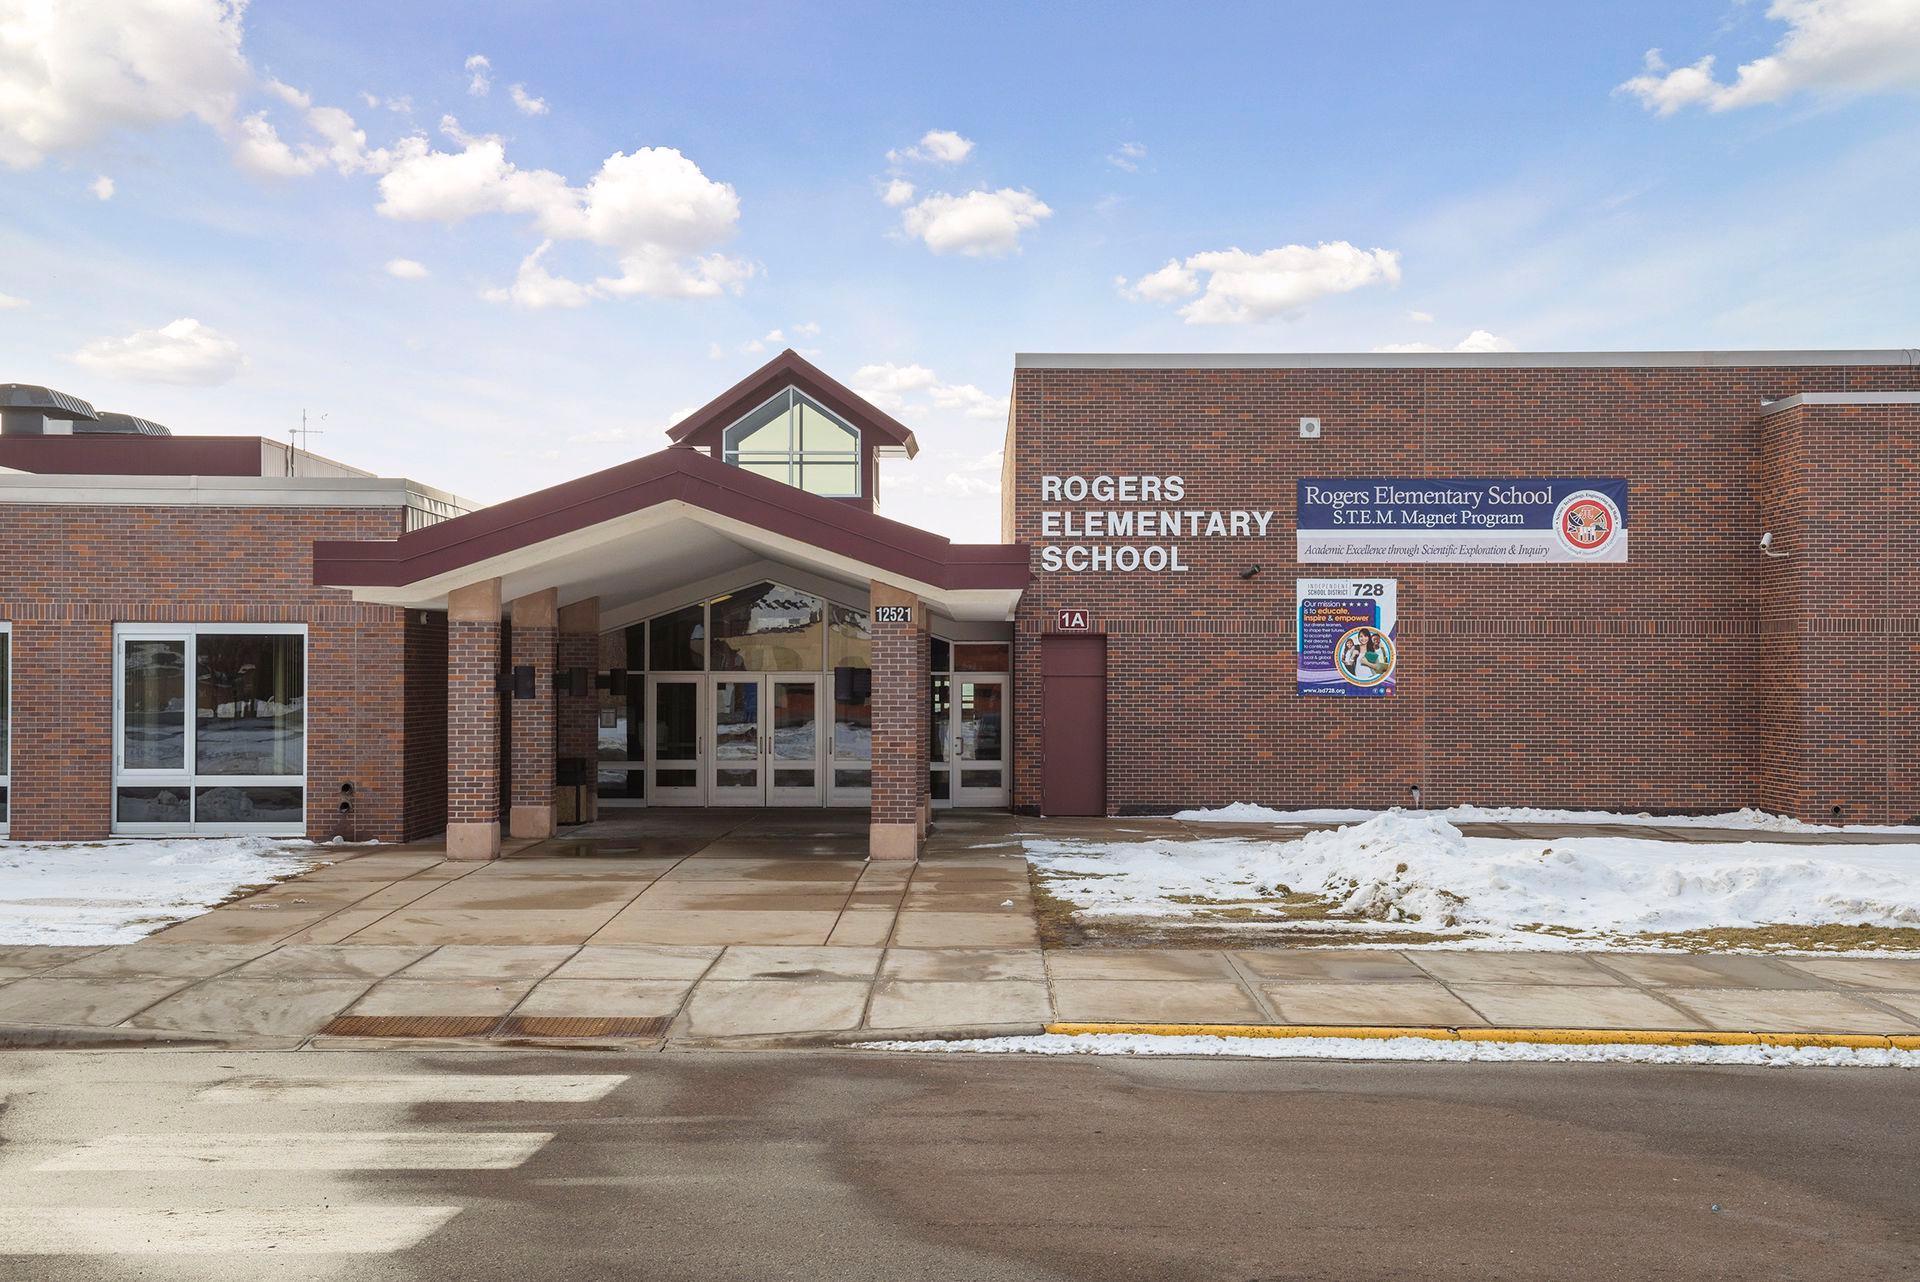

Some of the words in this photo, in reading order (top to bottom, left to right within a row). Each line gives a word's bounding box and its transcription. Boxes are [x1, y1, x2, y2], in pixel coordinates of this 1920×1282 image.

[1042, 475, 1185, 502] ROGERS
[1305, 487, 1369, 508] Rogers
[1374, 487, 1481, 508] Elementary
[1488, 486, 1552, 505] School
[1042, 511, 1274, 537] ELEMENTARY
[1334, 510, 1396, 525] S.T.E.M.
[1401, 510, 1456, 528] Magnet
[1461, 510, 1524, 528] Program
[1041, 545, 1189, 572] SCHOOL
[1305, 544, 1344, 555] Academic
[1346, 544, 1386, 555] Excellence
[1388, 544, 1420, 557] through
[1421, 544, 1458, 555] Scientific
[1459, 544, 1506, 557] Exploration
[1508, 545, 1516, 555] &
[1518, 545, 1549, 557] Inquiry
[1353, 584, 1384, 596] 728
[876, 607, 911, 621] 12521
[1062, 612, 1085, 627] 1A
